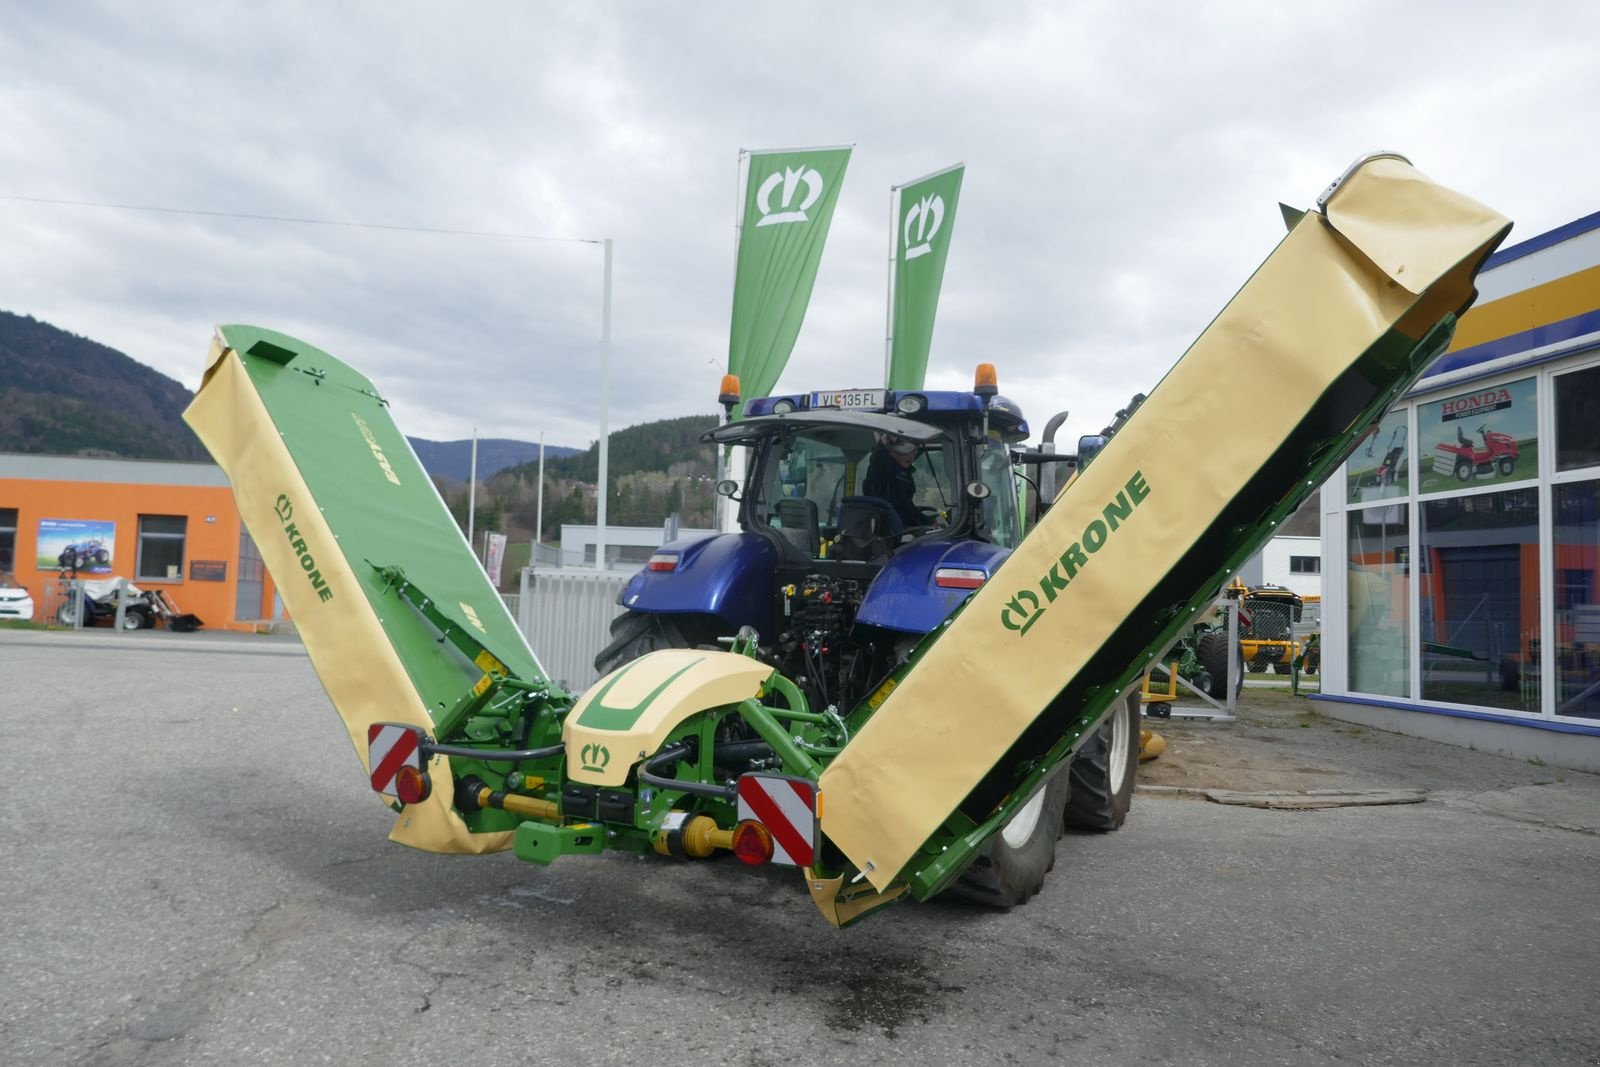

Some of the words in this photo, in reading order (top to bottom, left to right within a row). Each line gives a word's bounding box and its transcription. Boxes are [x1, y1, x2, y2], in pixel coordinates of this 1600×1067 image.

[823, 395, 834, 406] VI
[1442, 388, 1512, 415] HONDA
[285, 523, 333, 603] KRONE
[1039, 469, 1151, 604] KRONE
